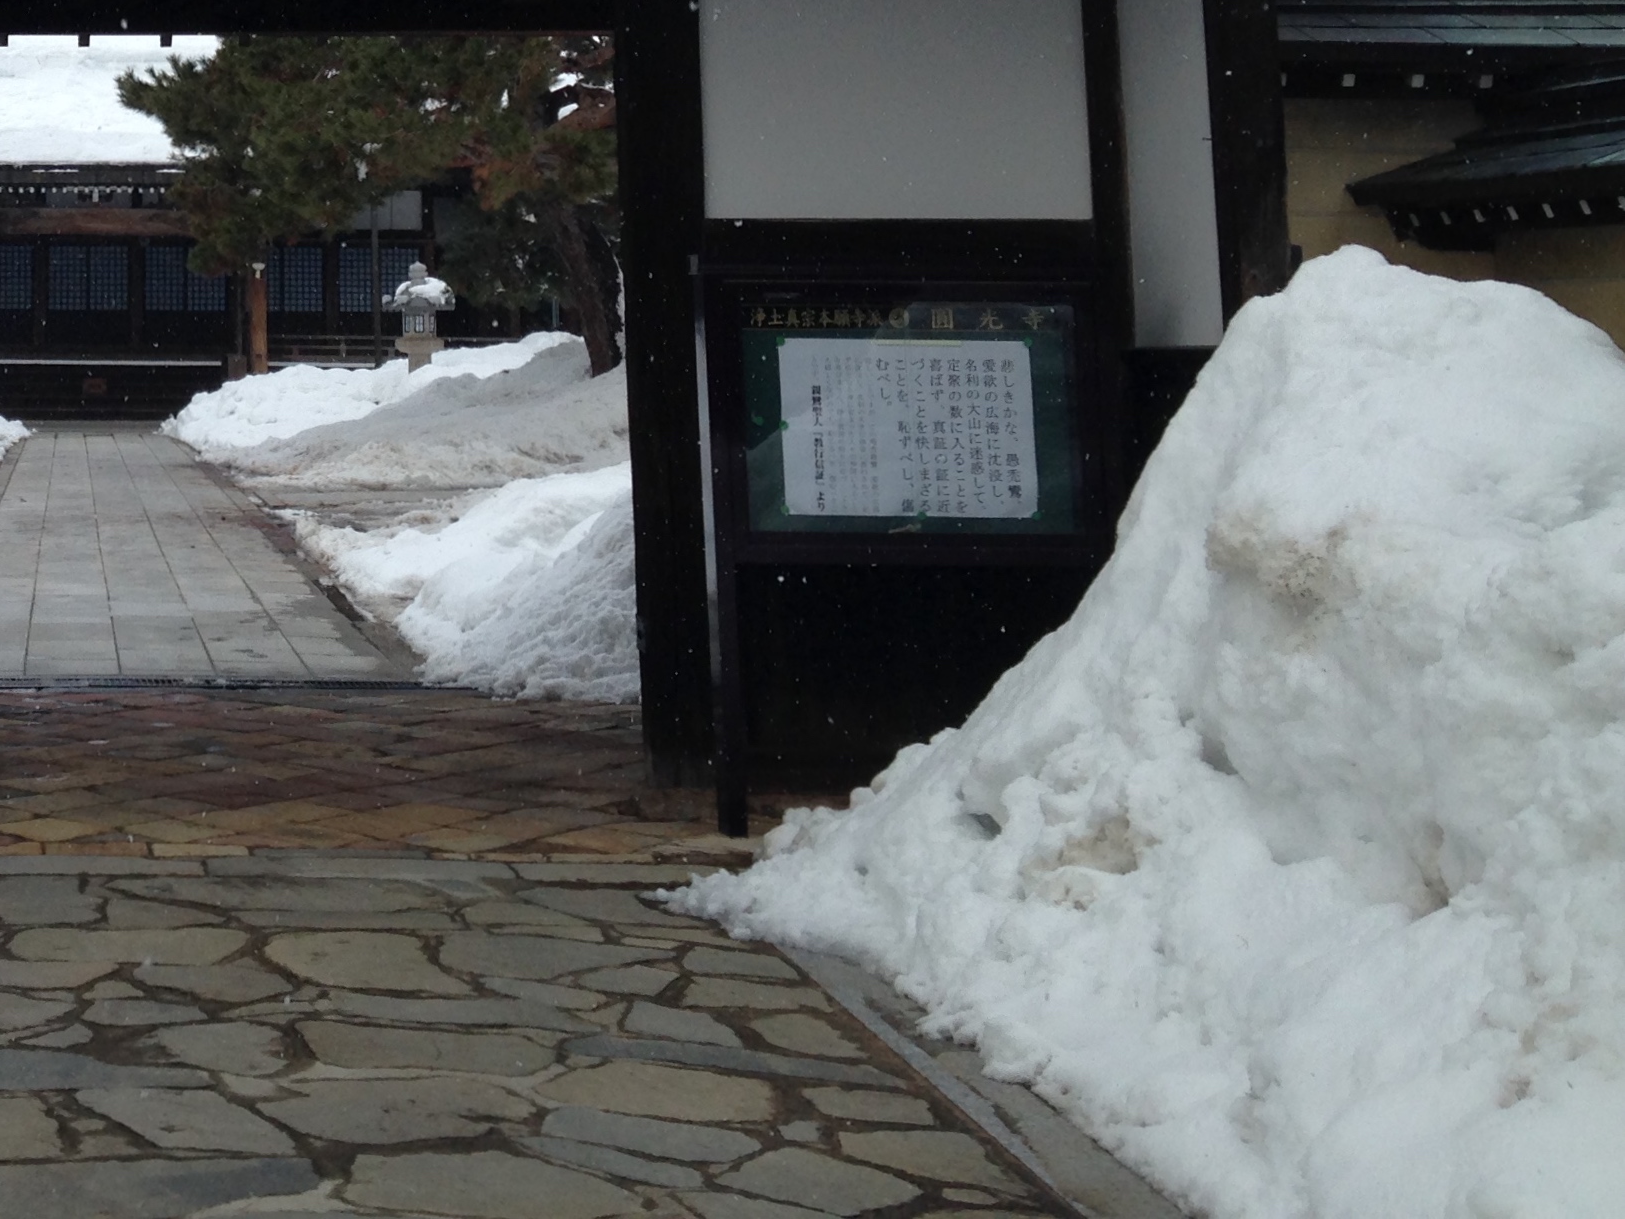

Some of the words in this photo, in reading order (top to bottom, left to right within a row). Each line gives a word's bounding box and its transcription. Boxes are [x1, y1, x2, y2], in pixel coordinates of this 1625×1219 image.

[750, 308, 884, 329] 浄土真宗本願寺派
[931, 307, 1046, 331] 圓光寺
[876, 358, 893, 407] むべし。
[911, 358, 931, 512] づくことを快しまざる
[947, 358, 968, 514] 定聚の数に入ることを
[965, 358, 987, 511] 名利の大山に迷惑して、
[982, 358, 1005, 506] 愛欲の広海に沈没し、
